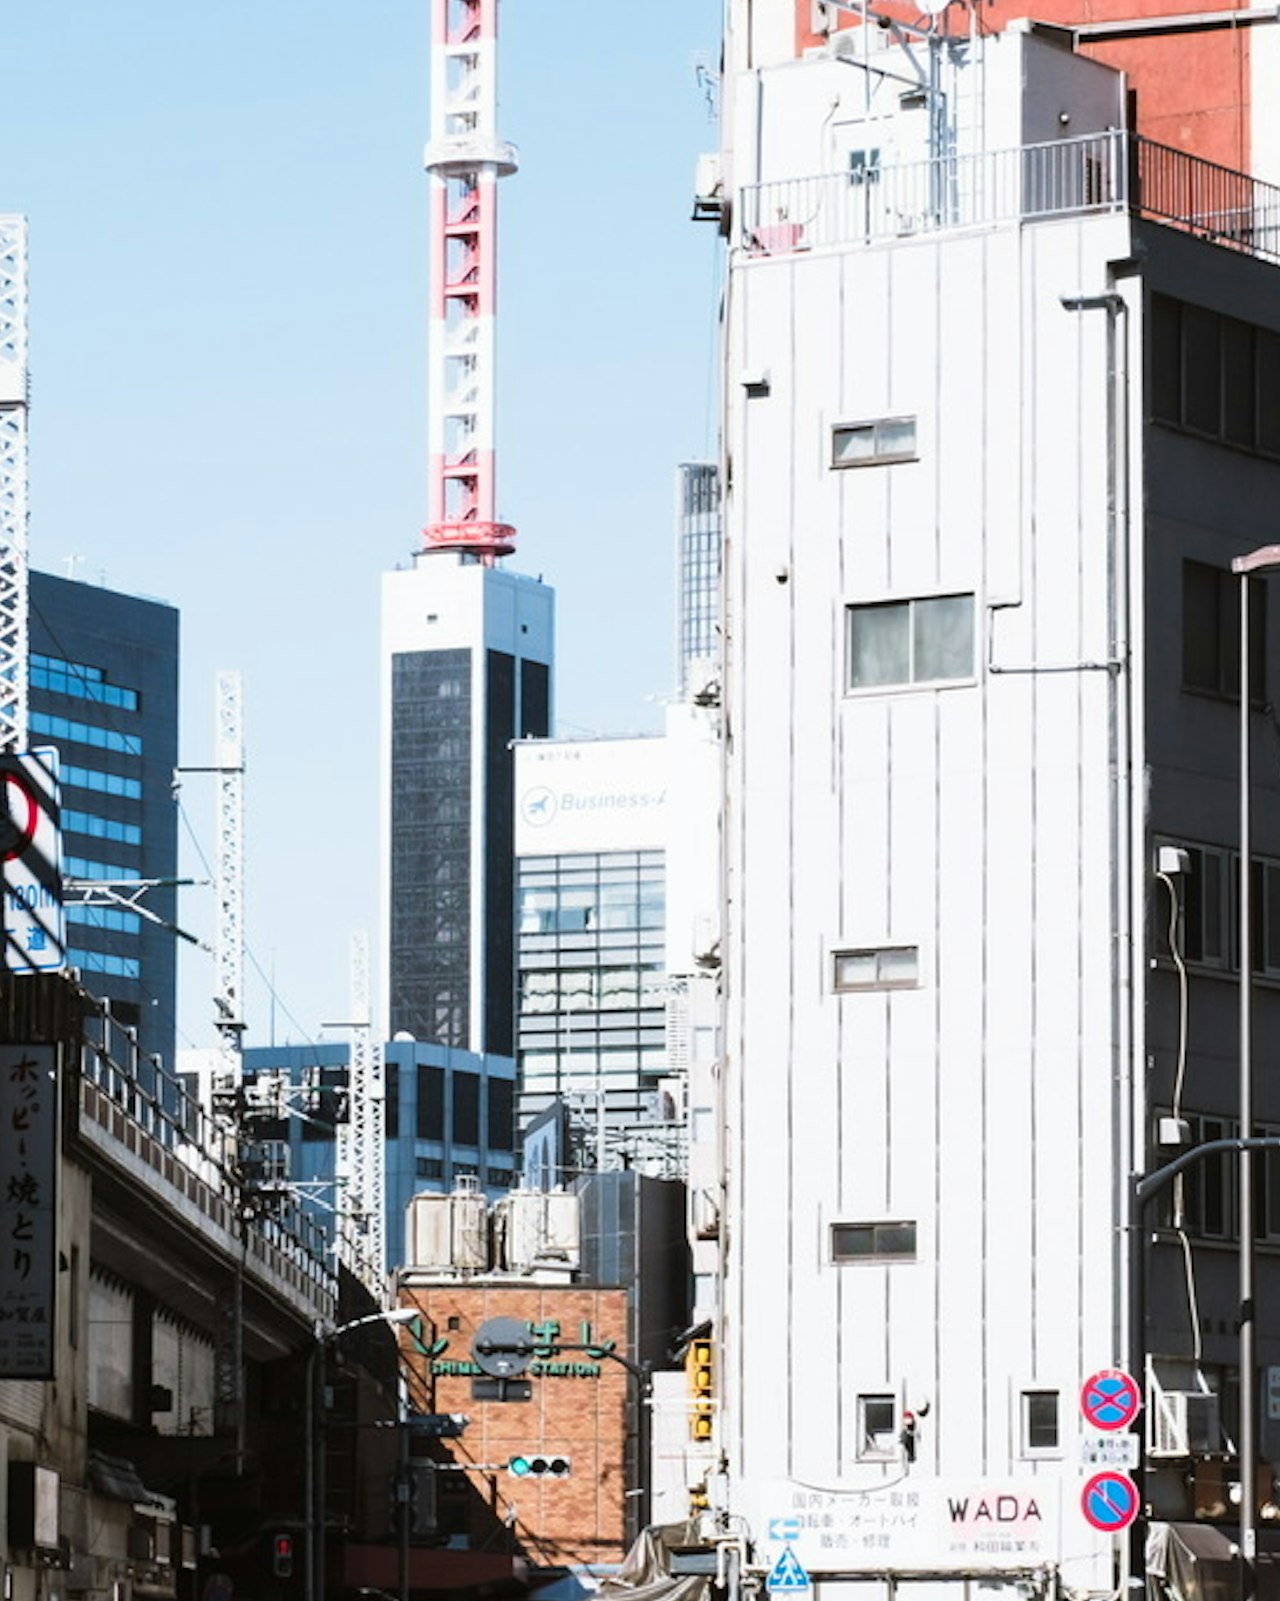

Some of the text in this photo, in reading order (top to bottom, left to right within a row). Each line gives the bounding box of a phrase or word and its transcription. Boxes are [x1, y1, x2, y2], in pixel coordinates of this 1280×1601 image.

[7, 1053, 40, 1280] ホッピー・焼とり
[410, 1315, 616, 1357] しばし
[529, 1362, 601, 1377] STATION
[947, 1496, 1042, 1523] WADA
